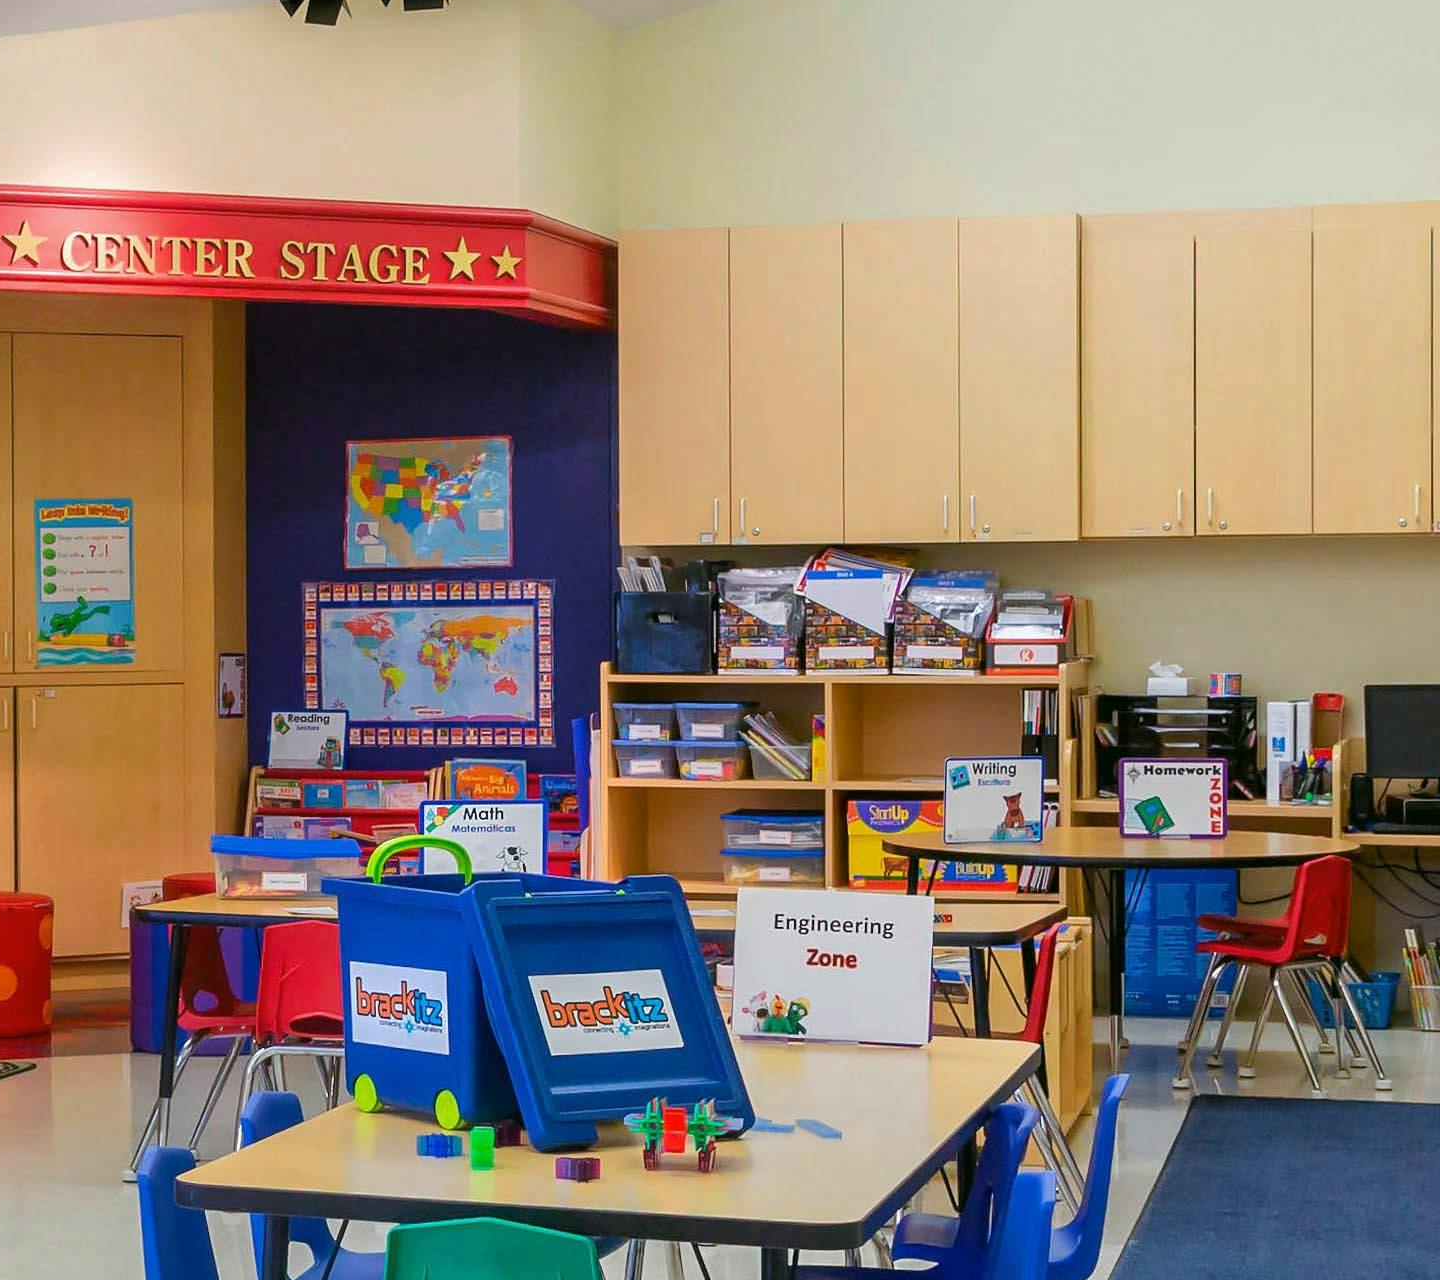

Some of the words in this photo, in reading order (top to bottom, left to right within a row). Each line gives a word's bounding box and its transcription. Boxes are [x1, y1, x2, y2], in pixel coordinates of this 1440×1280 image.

[60, 231, 255, 278] CENTER
[278, 240, 431, 284] STAGE
[288, 714, 330, 725] Reading
[972, 762, 1016, 777] Writing
[1144, 765, 1221, 776] Homework
[474, 784, 515, 794] Animals
[463, 807, 504, 820] Math
[1209, 778, 1222, 833] ZONE
[452, 824, 515, 833] Matemáticas
[773, 913, 894, 939] Engineering
[806, 949, 858, 969] Zone
[355, 977, 443, 1027] brackitz
[540, 986, 669, 1028] brackitz
